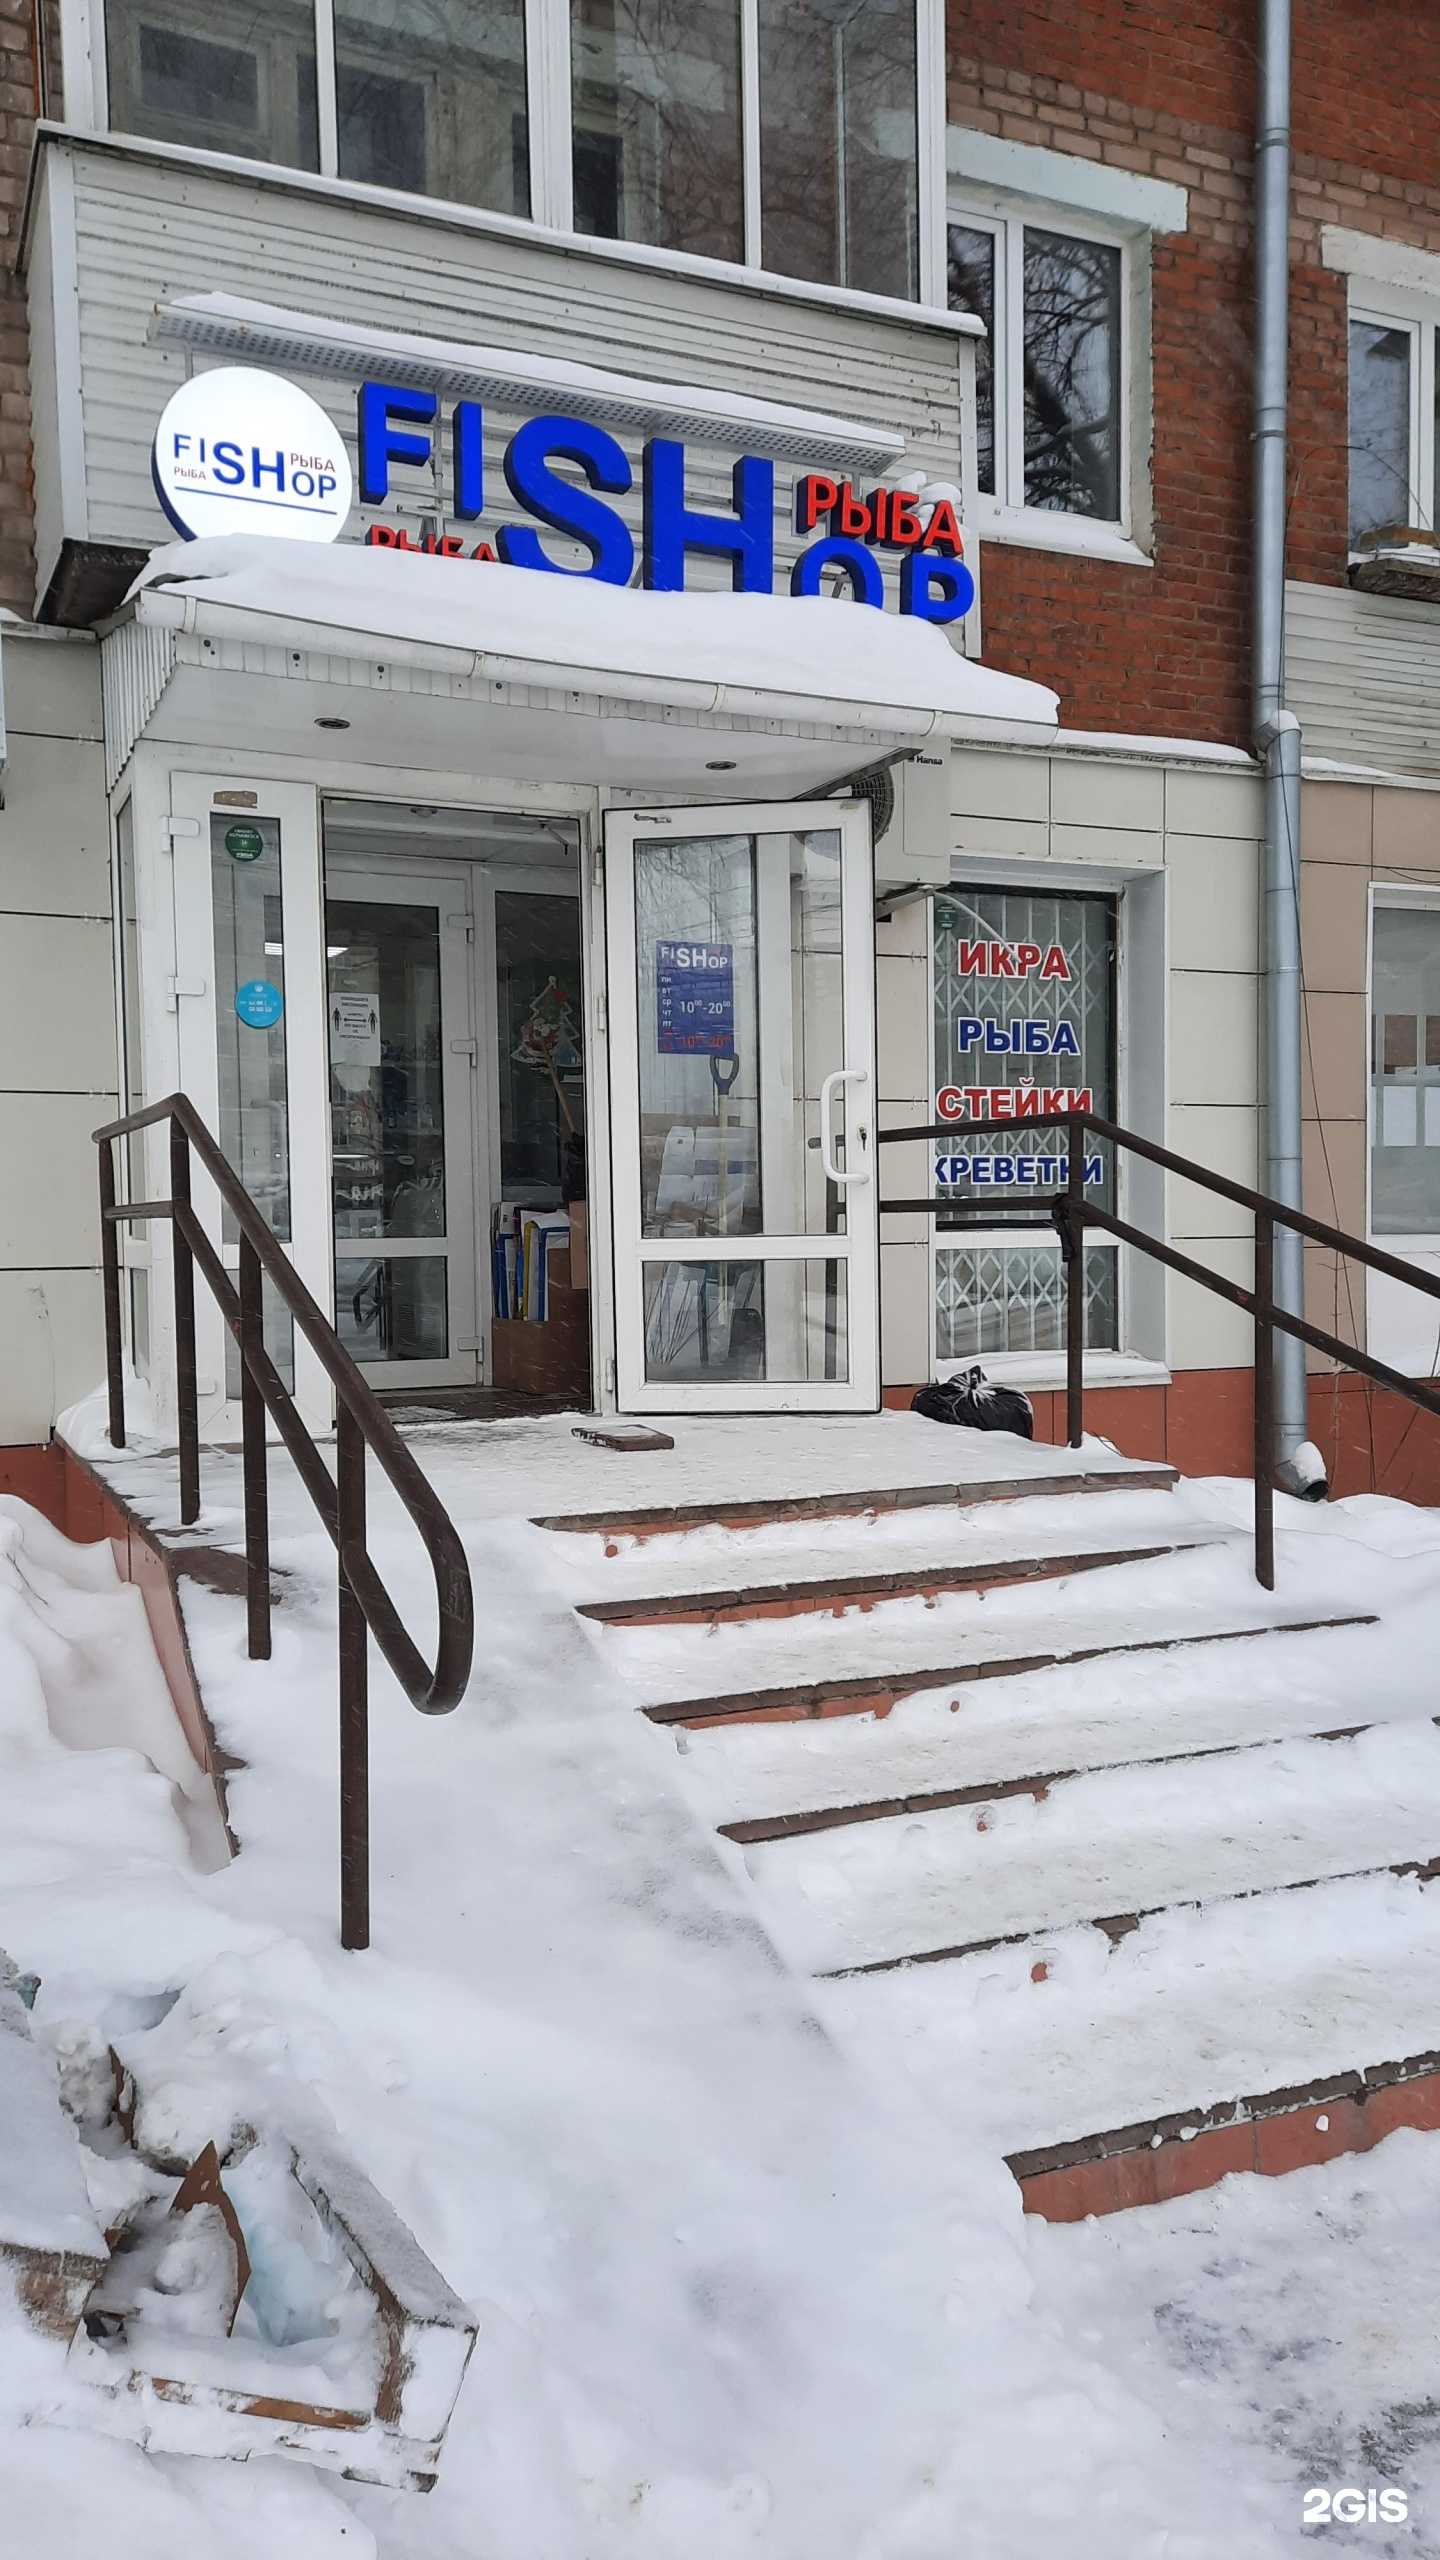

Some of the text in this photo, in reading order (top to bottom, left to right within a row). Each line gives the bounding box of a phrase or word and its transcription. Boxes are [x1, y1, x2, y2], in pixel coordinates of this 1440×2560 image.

[174, 465, 207, 480] РЫБА
[290, 452, 336, 473] РЫБА
[797, 474, 964, 558] РЫБА
[959, 939, 1072, 981] ИКРА
[958, 1017, 1080, 1055] РЫБА
[937, 1077, 1093, 1119] СТЕЙКИ
